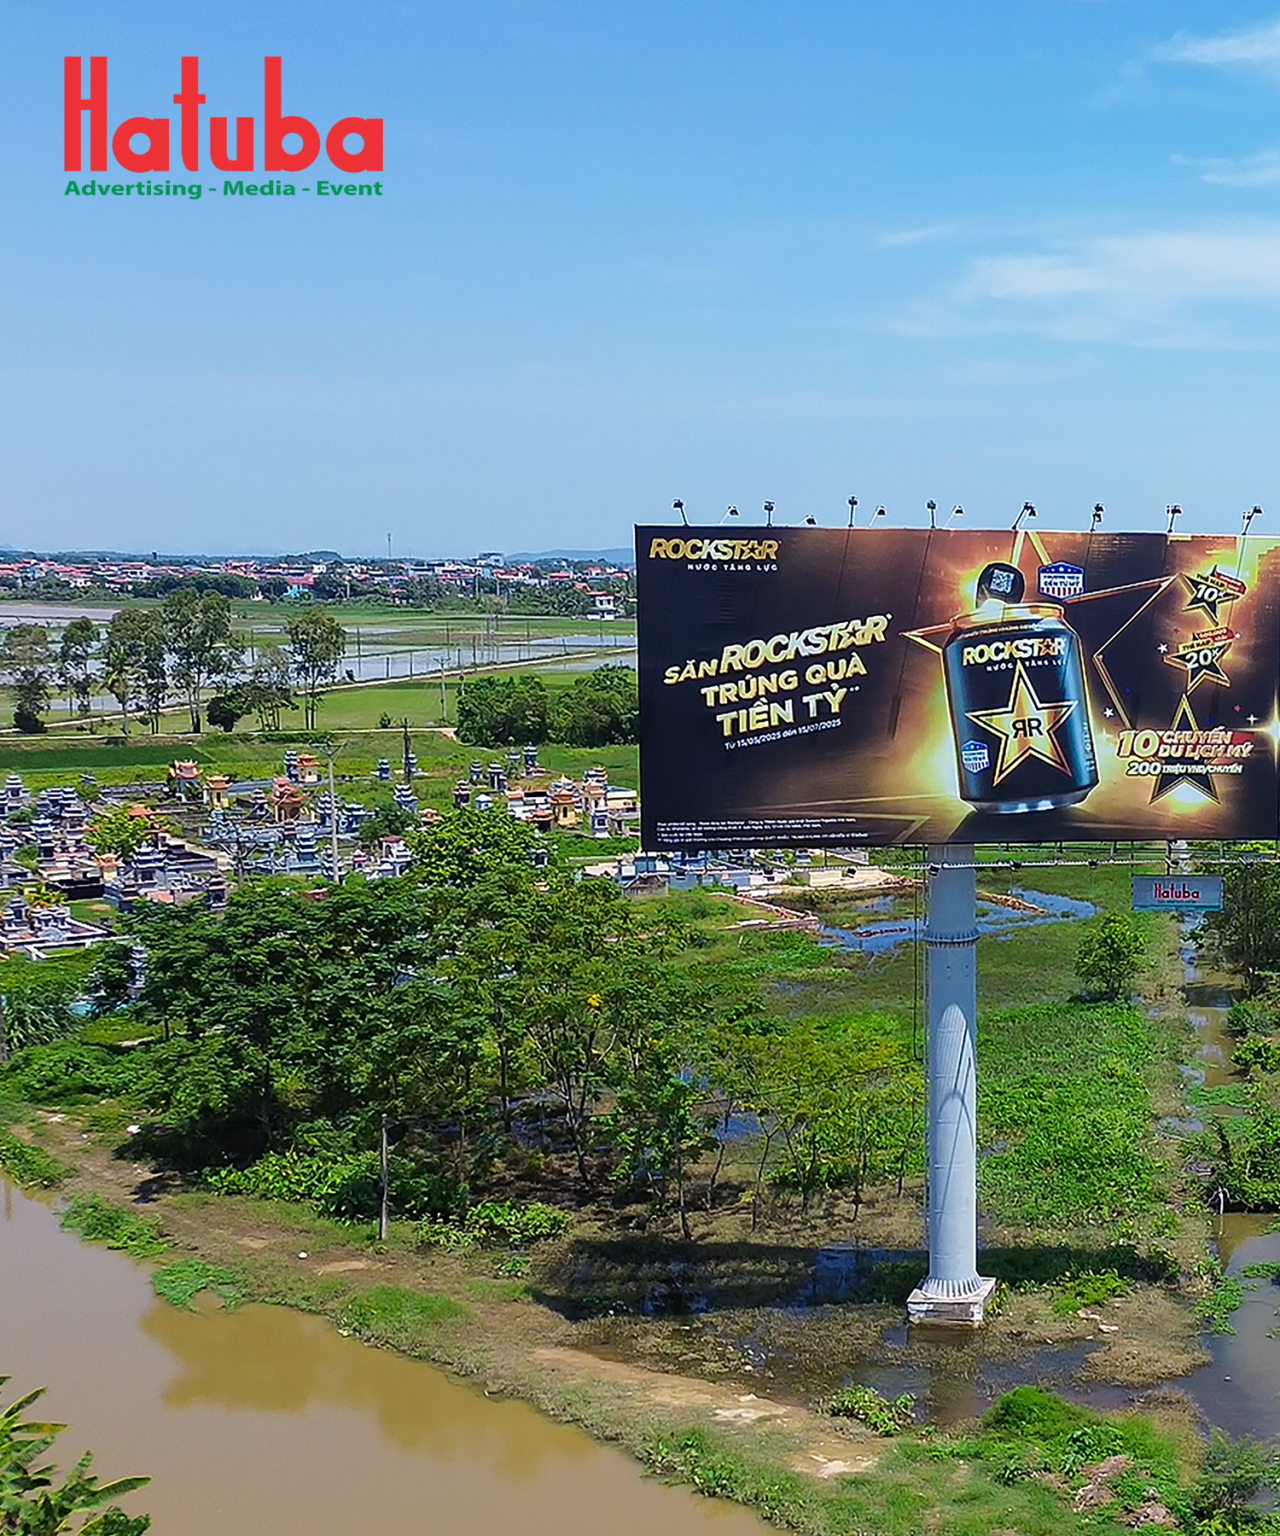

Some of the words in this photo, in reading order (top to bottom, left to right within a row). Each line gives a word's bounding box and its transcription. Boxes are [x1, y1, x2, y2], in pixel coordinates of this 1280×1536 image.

[649, 537, 780, 560] ROCKSTAR
[663, 658, 719, 684] SĂN
[719, 614, 889, 674] ROCKSTAR
[962, 637, 1066, 666] ROCKSTAR
[700, 670, 798, 707] TRÚNG
[805, 652, 867, 685] QUÀ
[716, 697, 793, 737] TIỀN
[1158, 744, 1184, 758] DU
[1127, 762, 1162, 775] 200
[1155, 883, 1201, 900] Hatuba
